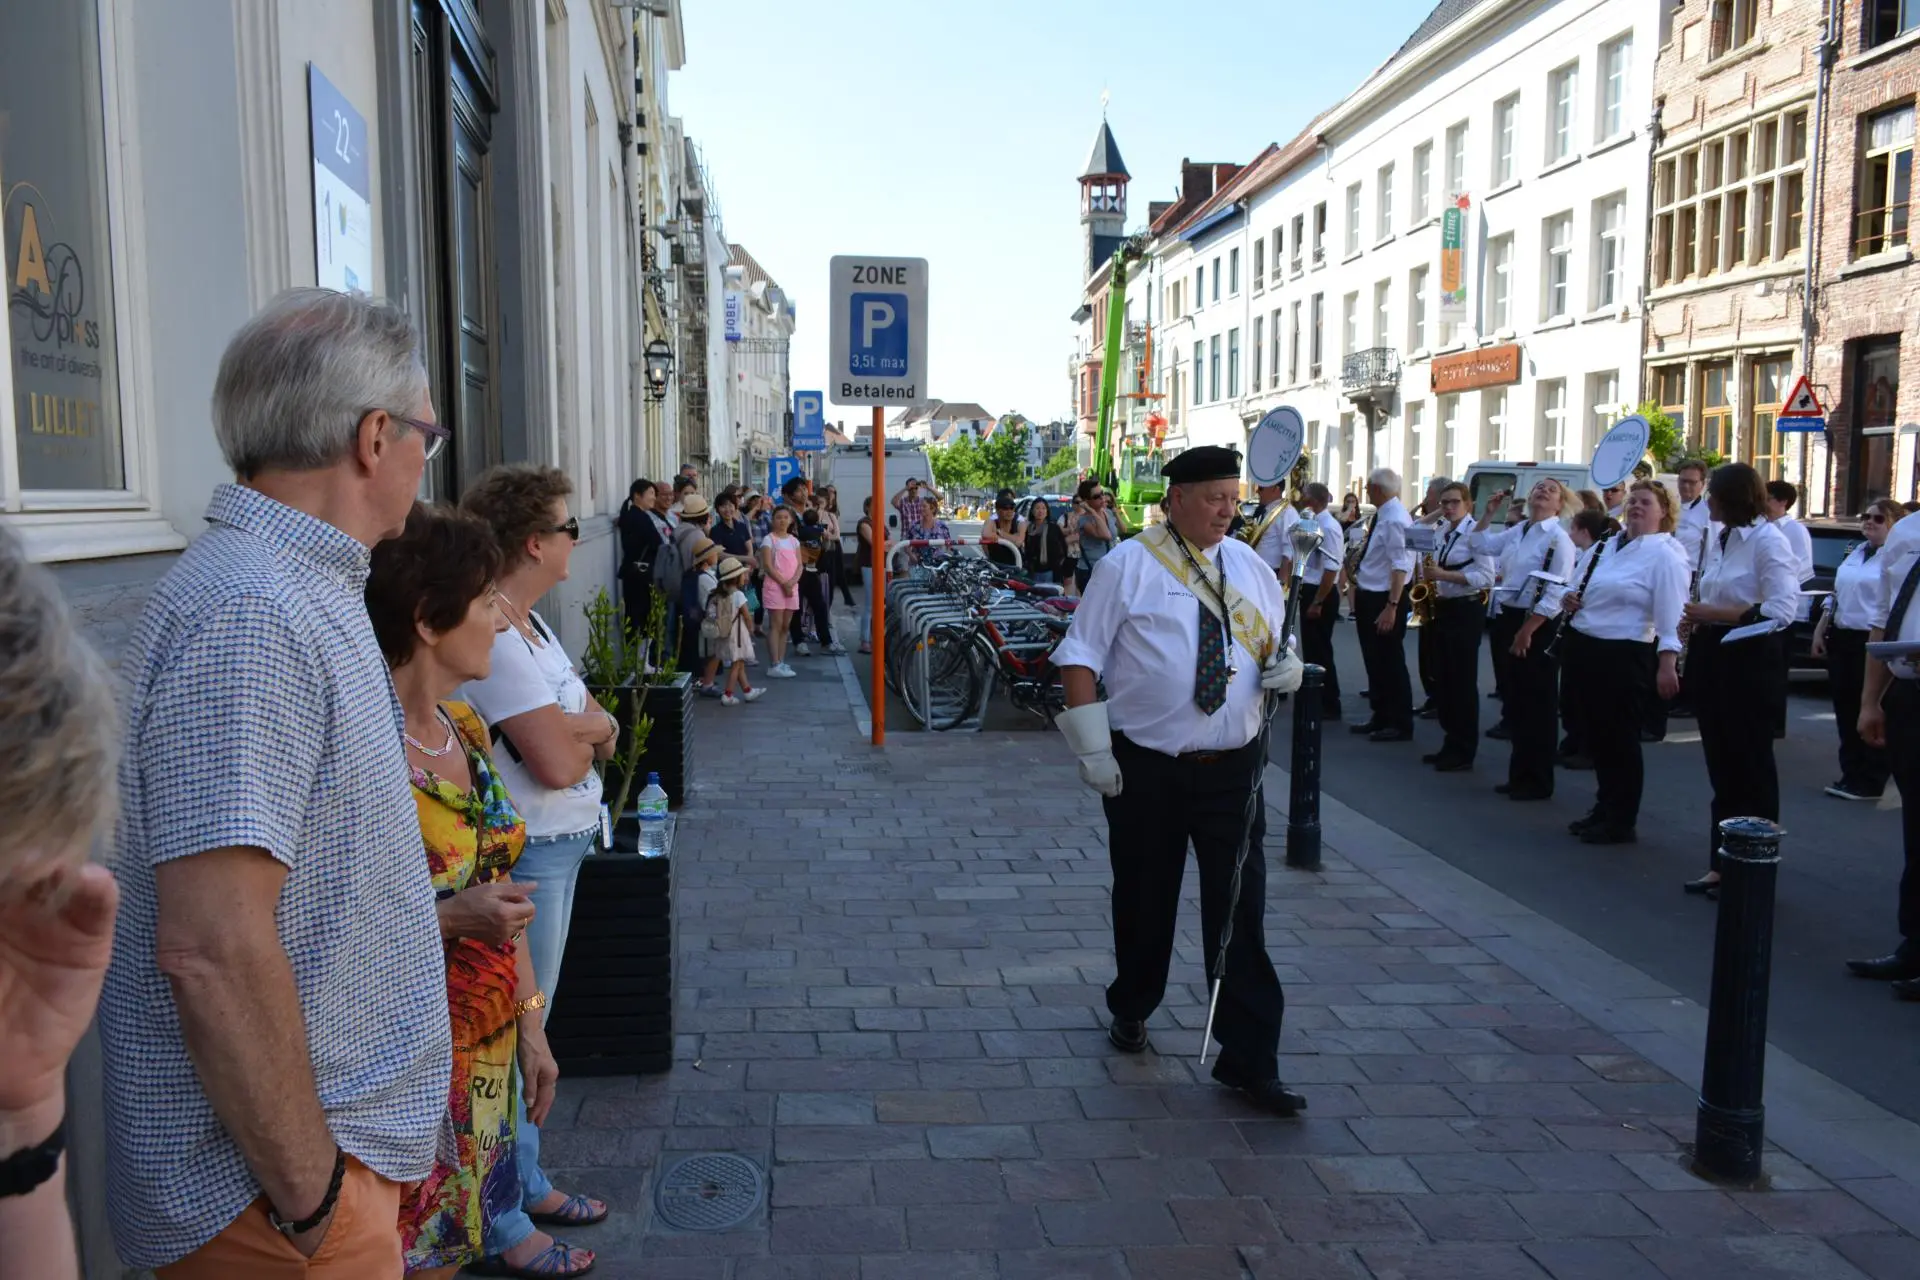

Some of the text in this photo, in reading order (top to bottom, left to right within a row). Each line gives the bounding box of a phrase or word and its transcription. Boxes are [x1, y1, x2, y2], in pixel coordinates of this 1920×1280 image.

[334, 109, 351, 164] 22
[852, 265, 907, 285] ZONE
[863, 301, 896, 348] P
[852, 354, 905, 369] 3,5t max
[841, 382, 915, 399] Betalend
[798, 396, 820, 429] P
[776, 461, 793, 485] P
